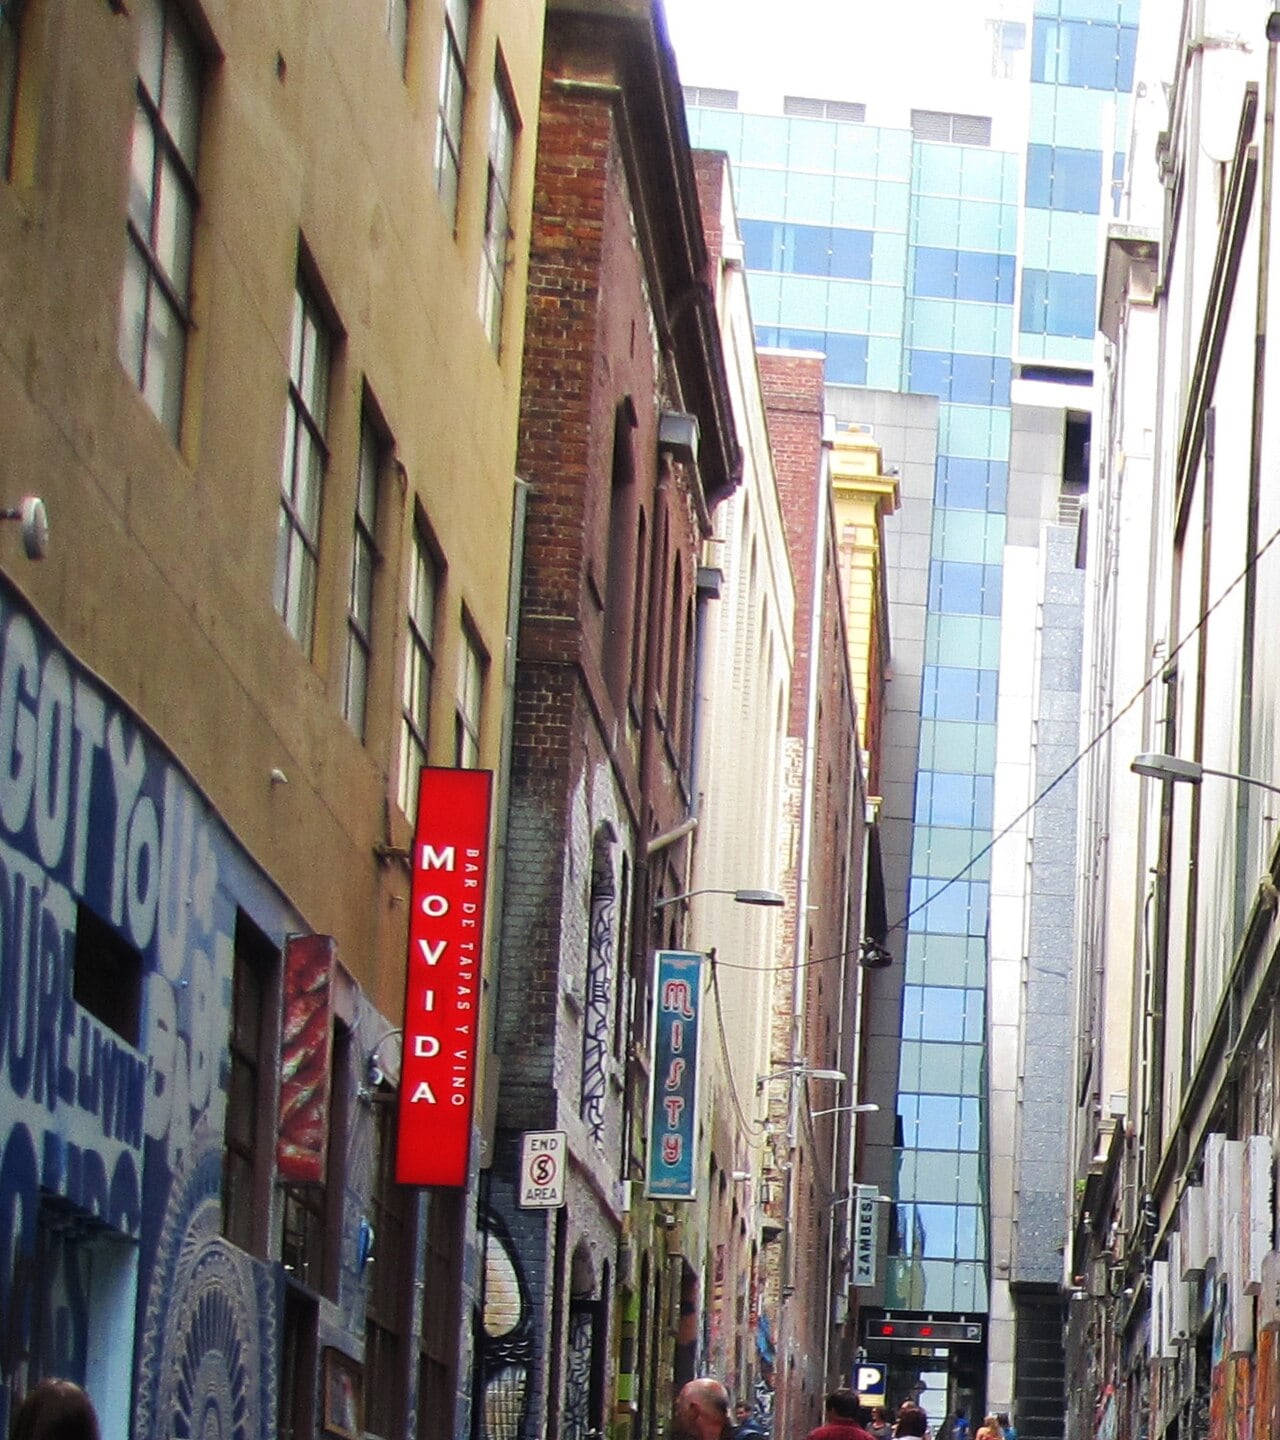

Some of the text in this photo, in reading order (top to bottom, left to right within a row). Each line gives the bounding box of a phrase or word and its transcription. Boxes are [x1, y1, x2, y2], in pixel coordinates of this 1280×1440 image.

[0, 612, 196, 980] GOT YOU
[411, 845, 455, 1104] MOVIDA
[451, 849, 480, 1106] BAR DE TAPAS Y VINO
[531, 1139, 558, 1151] END
[663, 979, 694, 1168] MISTY
[526, 1188, 557, 1200] AREA
[857, 1367, 881, 1391] P
